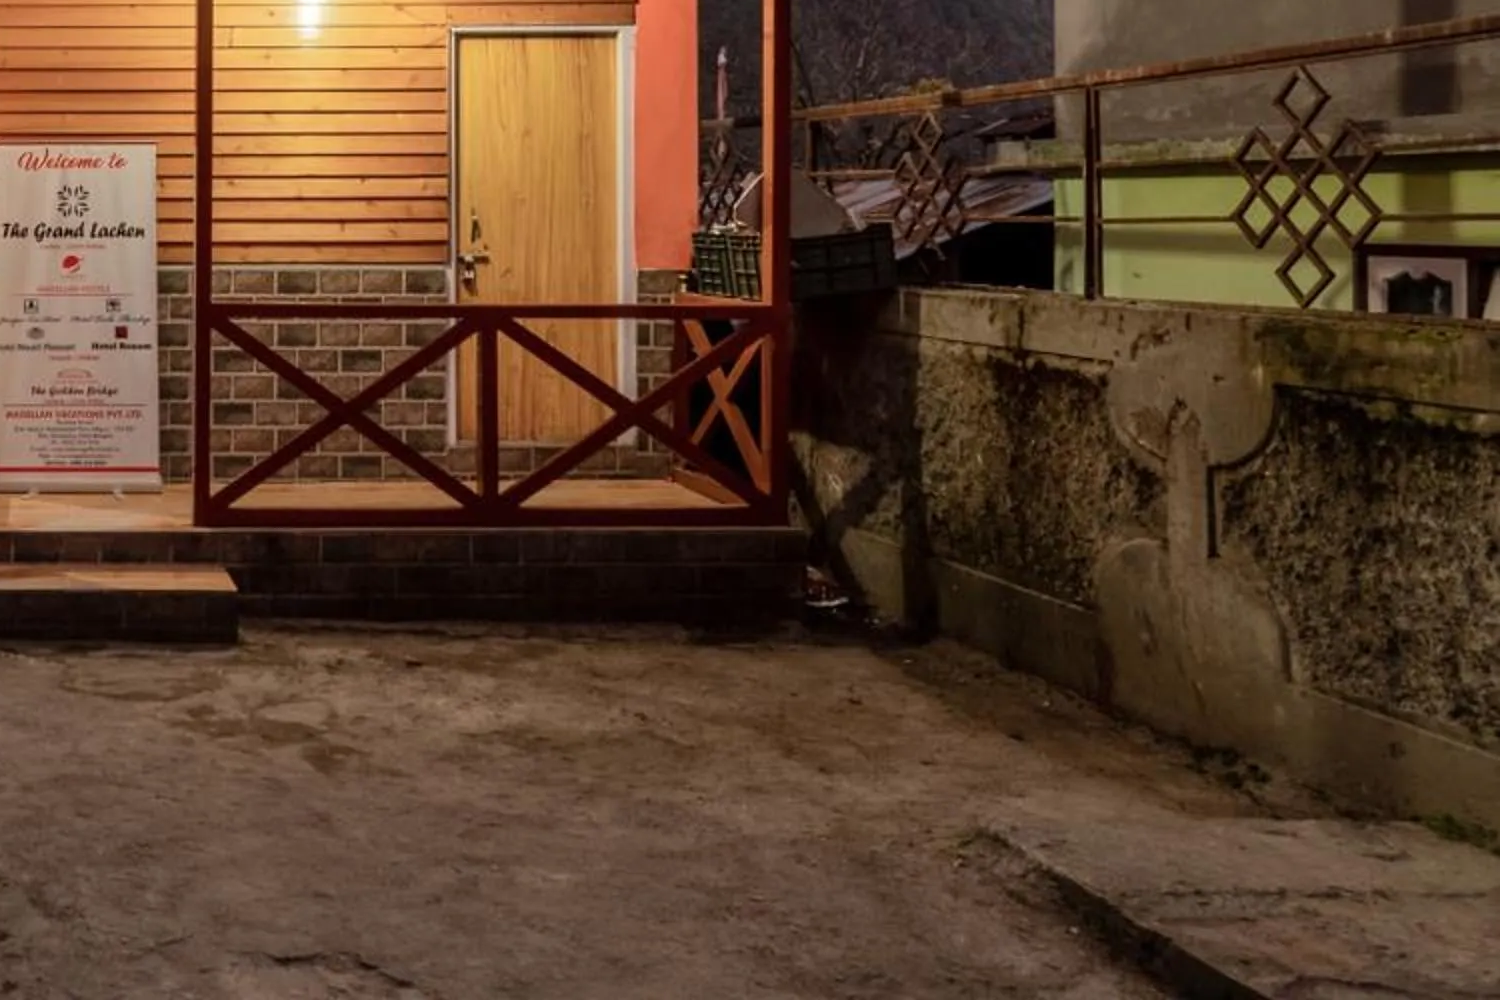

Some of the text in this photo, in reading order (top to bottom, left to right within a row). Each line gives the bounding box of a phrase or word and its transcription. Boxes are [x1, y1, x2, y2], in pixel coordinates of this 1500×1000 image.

[17, 147, 127, 171] Welcome to
[2, 222, 145, 242] The Grand Lachen
